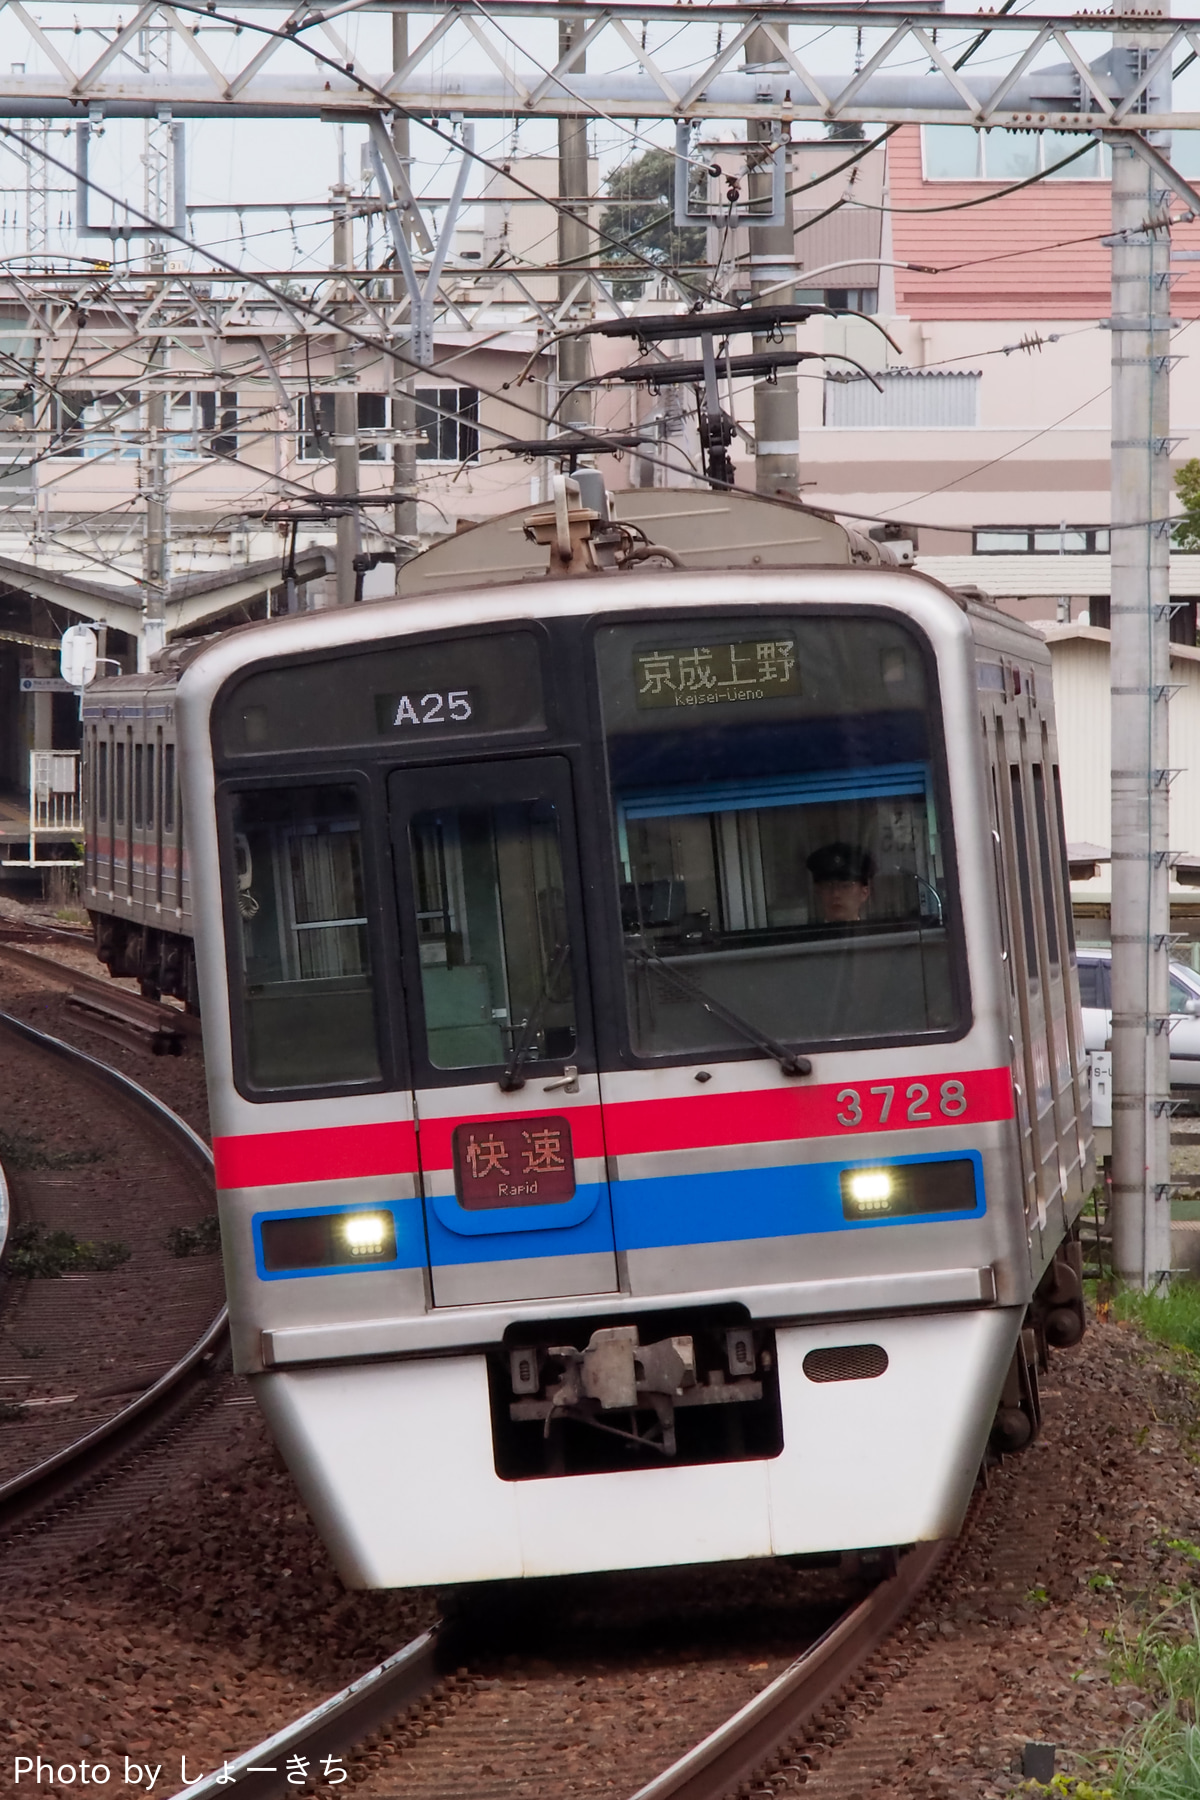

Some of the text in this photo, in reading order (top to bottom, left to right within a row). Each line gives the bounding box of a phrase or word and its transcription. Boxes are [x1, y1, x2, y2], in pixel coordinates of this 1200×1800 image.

[639, 641, 795, 693] 京成上野
[393, 690, 472, 726] A25
[675, 688, 764, 706] Keisei-Ueno
[836, 1079, 968, 1127] 3728
[466, 1128, 565, 1178] 快速
[498, 1180, 538, 1196] Rapid
